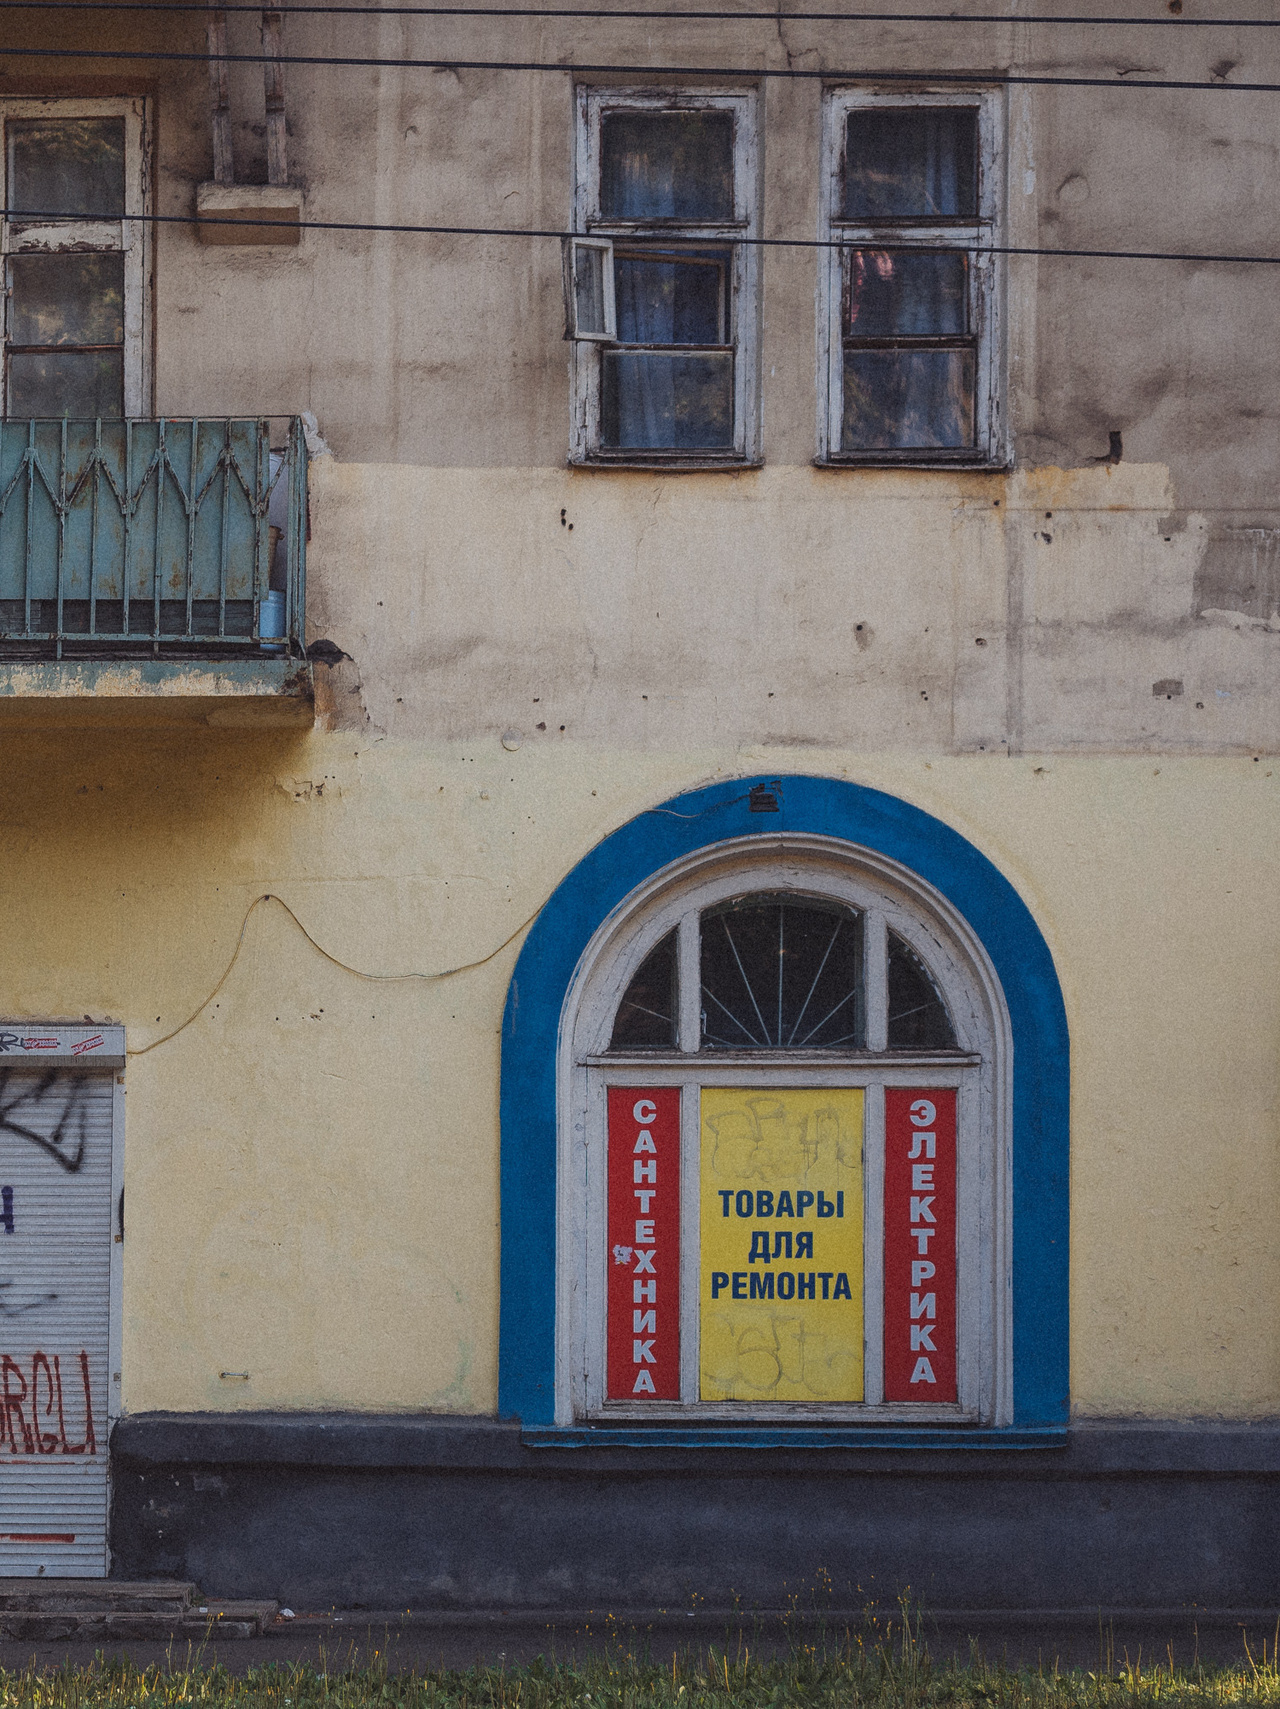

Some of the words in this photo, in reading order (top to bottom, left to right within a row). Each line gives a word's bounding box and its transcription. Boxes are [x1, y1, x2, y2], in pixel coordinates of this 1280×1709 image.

[718, 1190, 845, 1219] ТОВАРЫ
[632, 1099, 657, 1394] САНТЕХНИКА
[748, 1231, 815, 1264] ДЛЯ
[907, 1099, 937, 1384] ЭЛЕКТРИКА
[711, 1272, 853, 1301] РЕМОНТА
